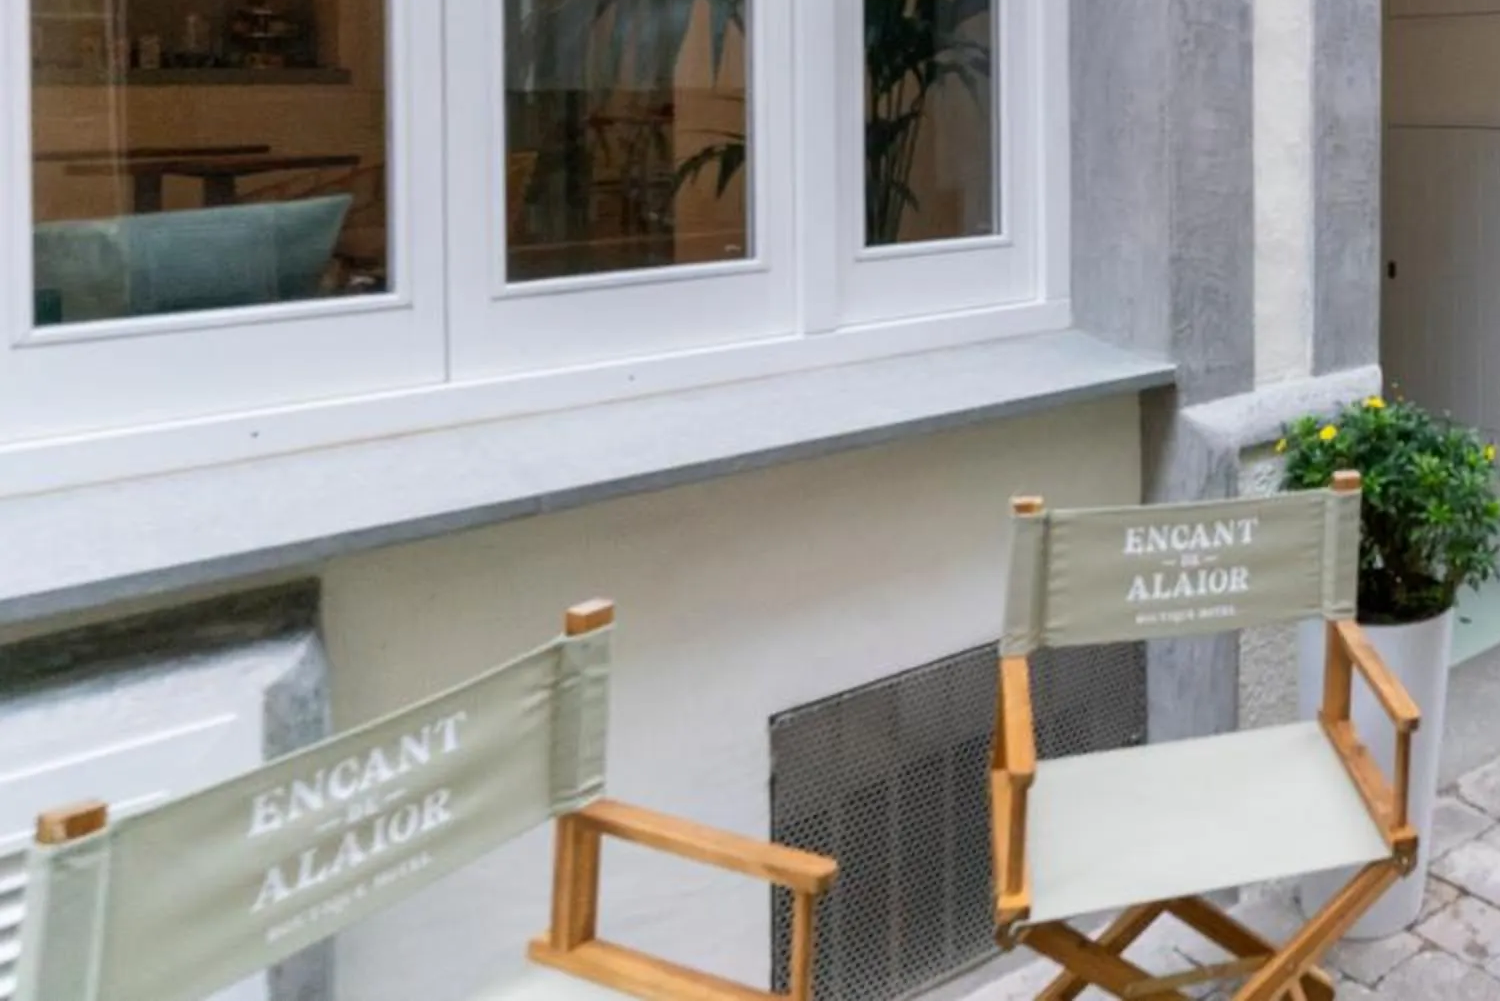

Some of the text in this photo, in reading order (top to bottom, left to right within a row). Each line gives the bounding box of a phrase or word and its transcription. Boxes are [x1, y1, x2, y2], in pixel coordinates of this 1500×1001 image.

[1125, 518, 1257, 554] ENCANT
[1128, 567, 1248, 600] ALAIOR
[249, 711, 466, 837] ENCANT
[252, 789, 453, 912] ALAIOR
